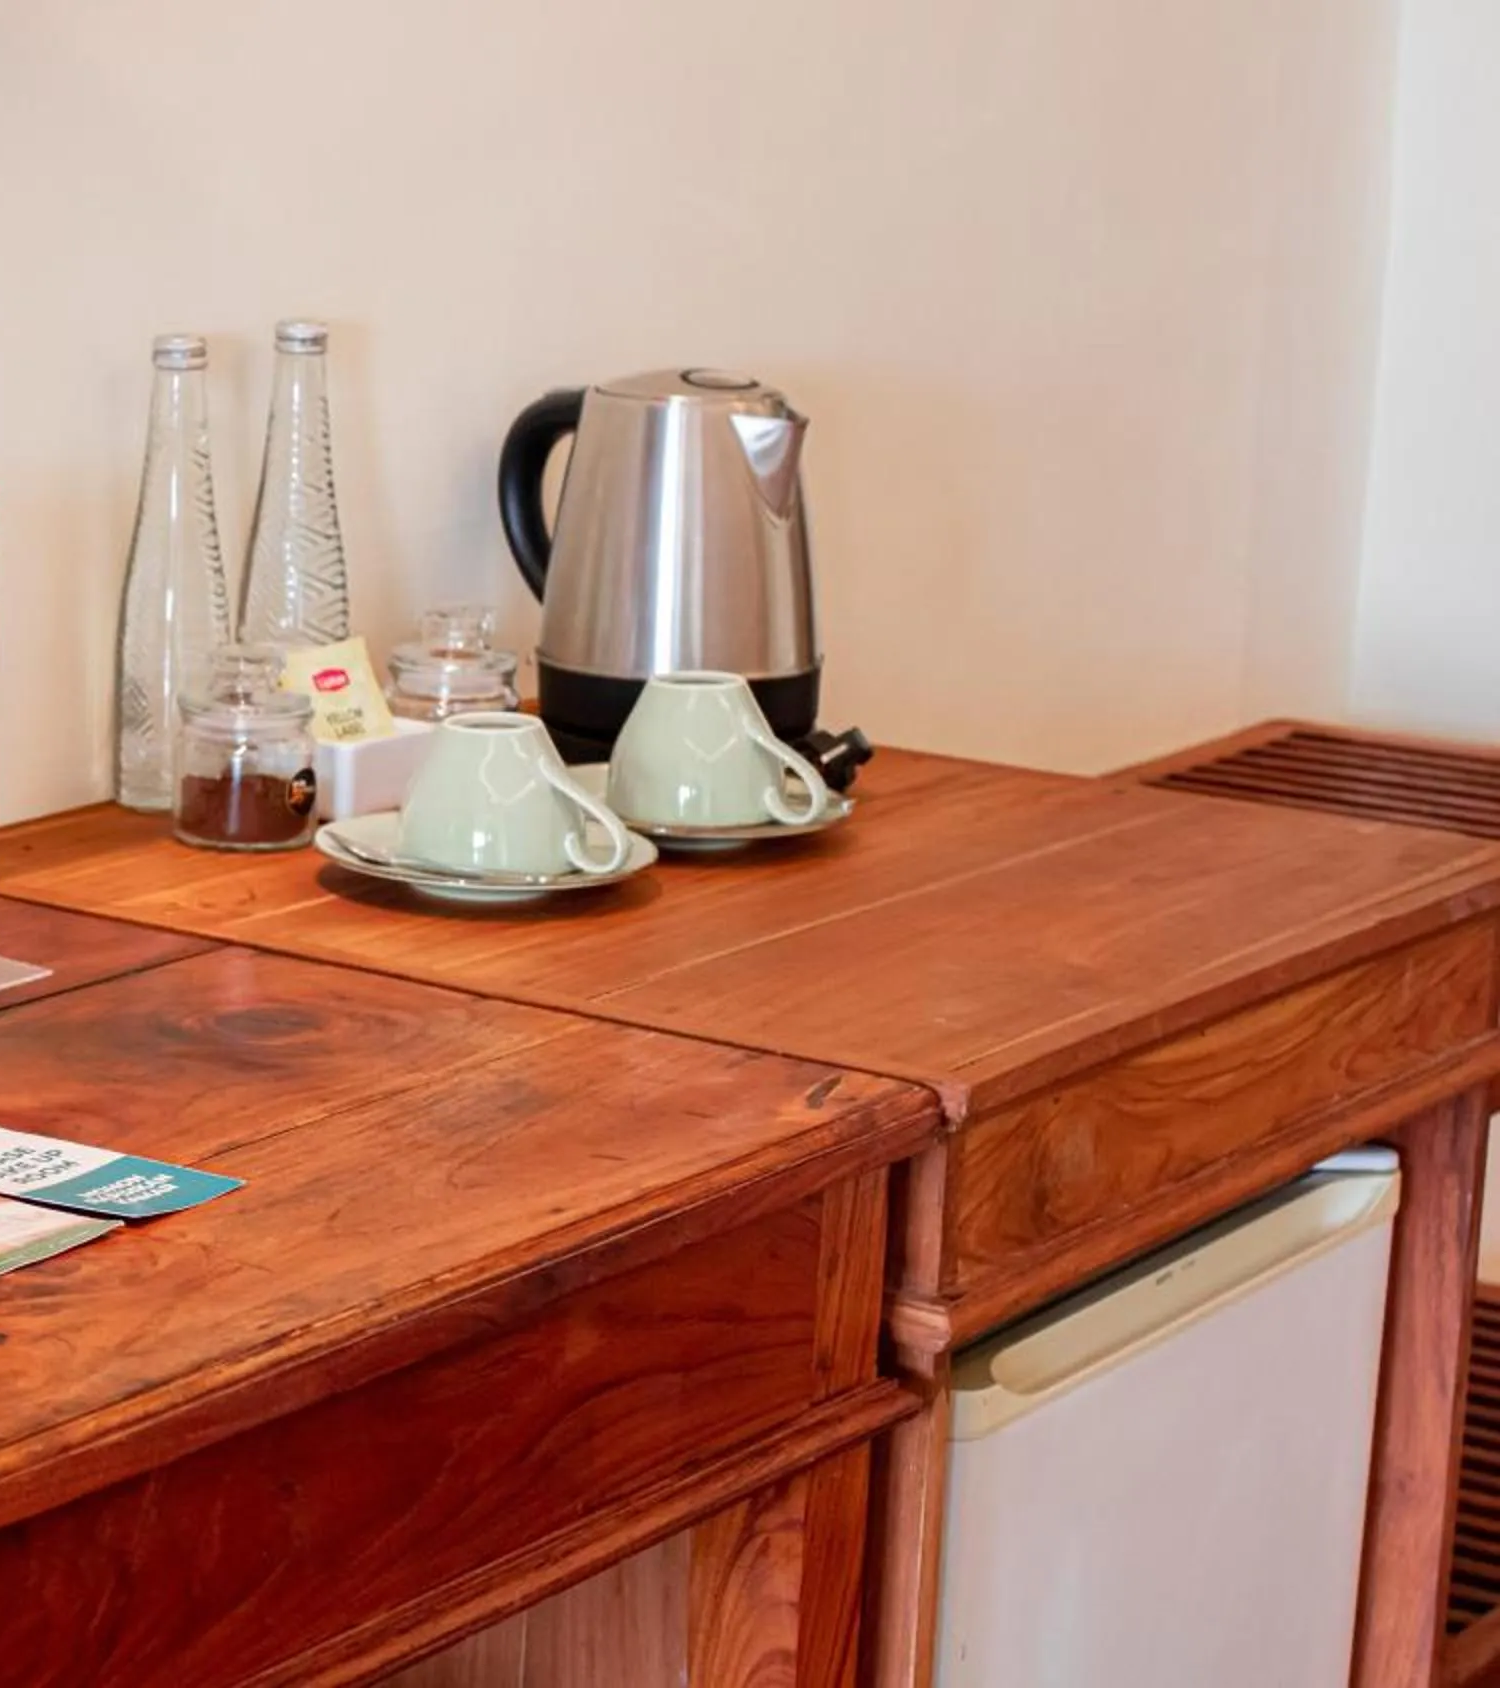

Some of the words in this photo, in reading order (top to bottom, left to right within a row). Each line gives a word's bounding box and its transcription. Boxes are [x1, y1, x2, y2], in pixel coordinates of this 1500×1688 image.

[326, 707, 364, 726] YELLOW
[32, 1149, 63, 1163] UP
[12, 1160, 79, 1185] ROOM
